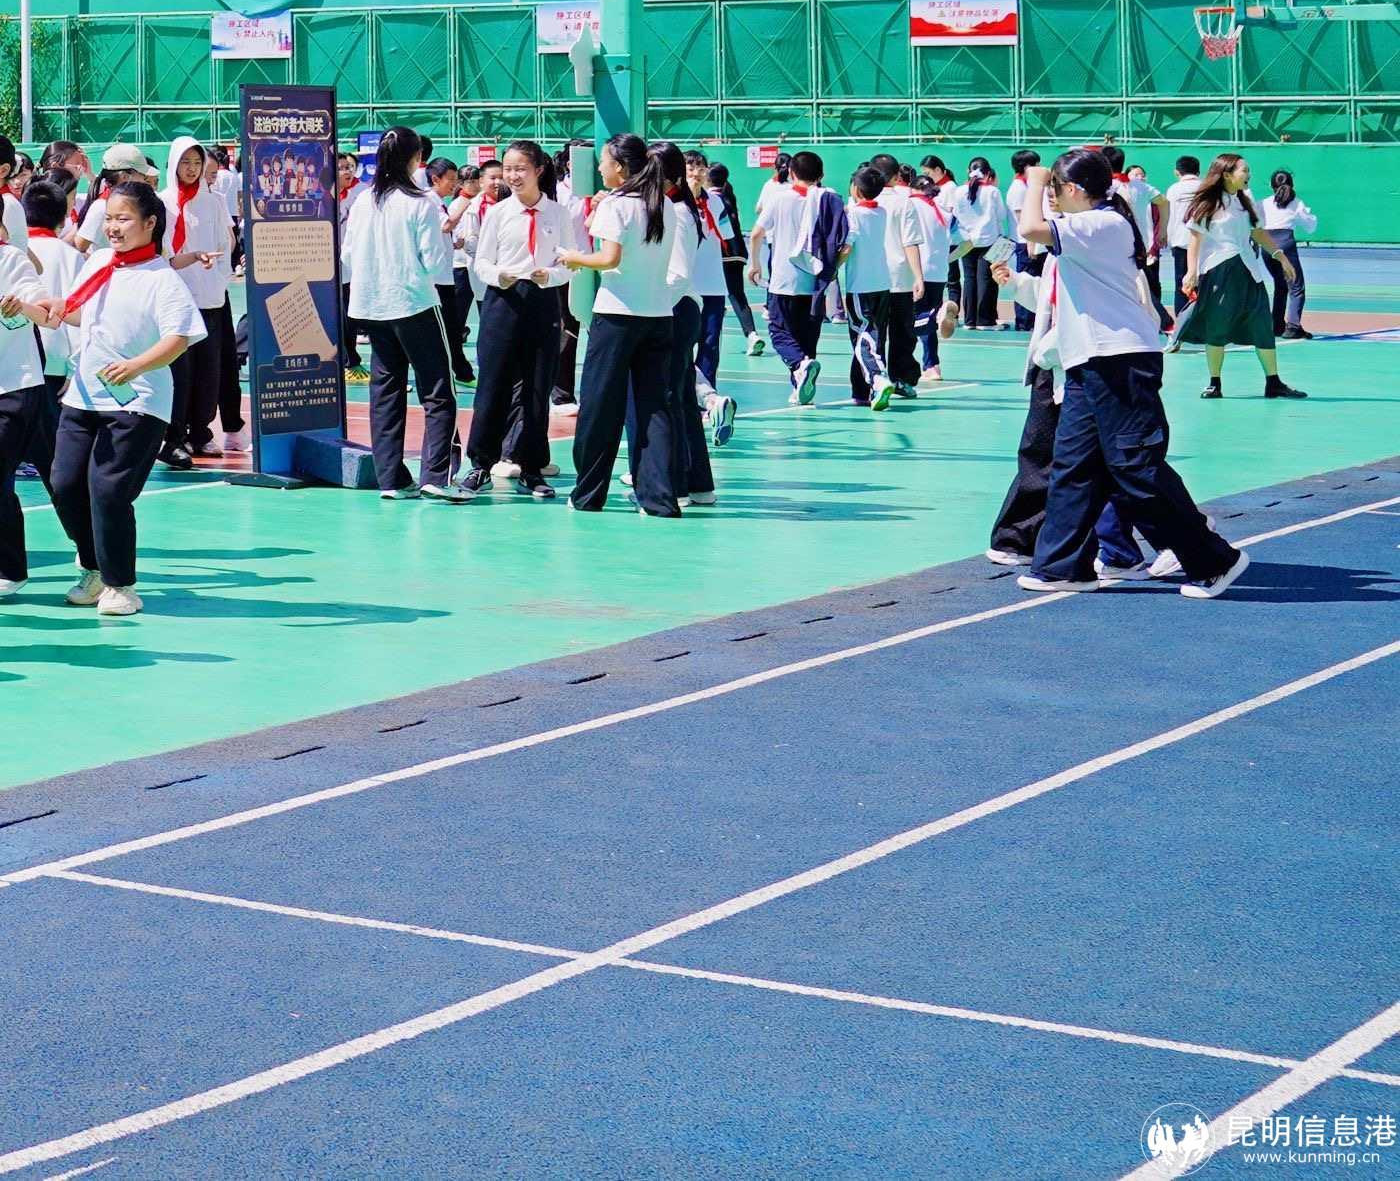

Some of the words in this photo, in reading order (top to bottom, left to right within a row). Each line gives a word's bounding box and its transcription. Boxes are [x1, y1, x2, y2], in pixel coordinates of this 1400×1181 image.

[253, 116, 324, 133] 法治守护者大闯关
